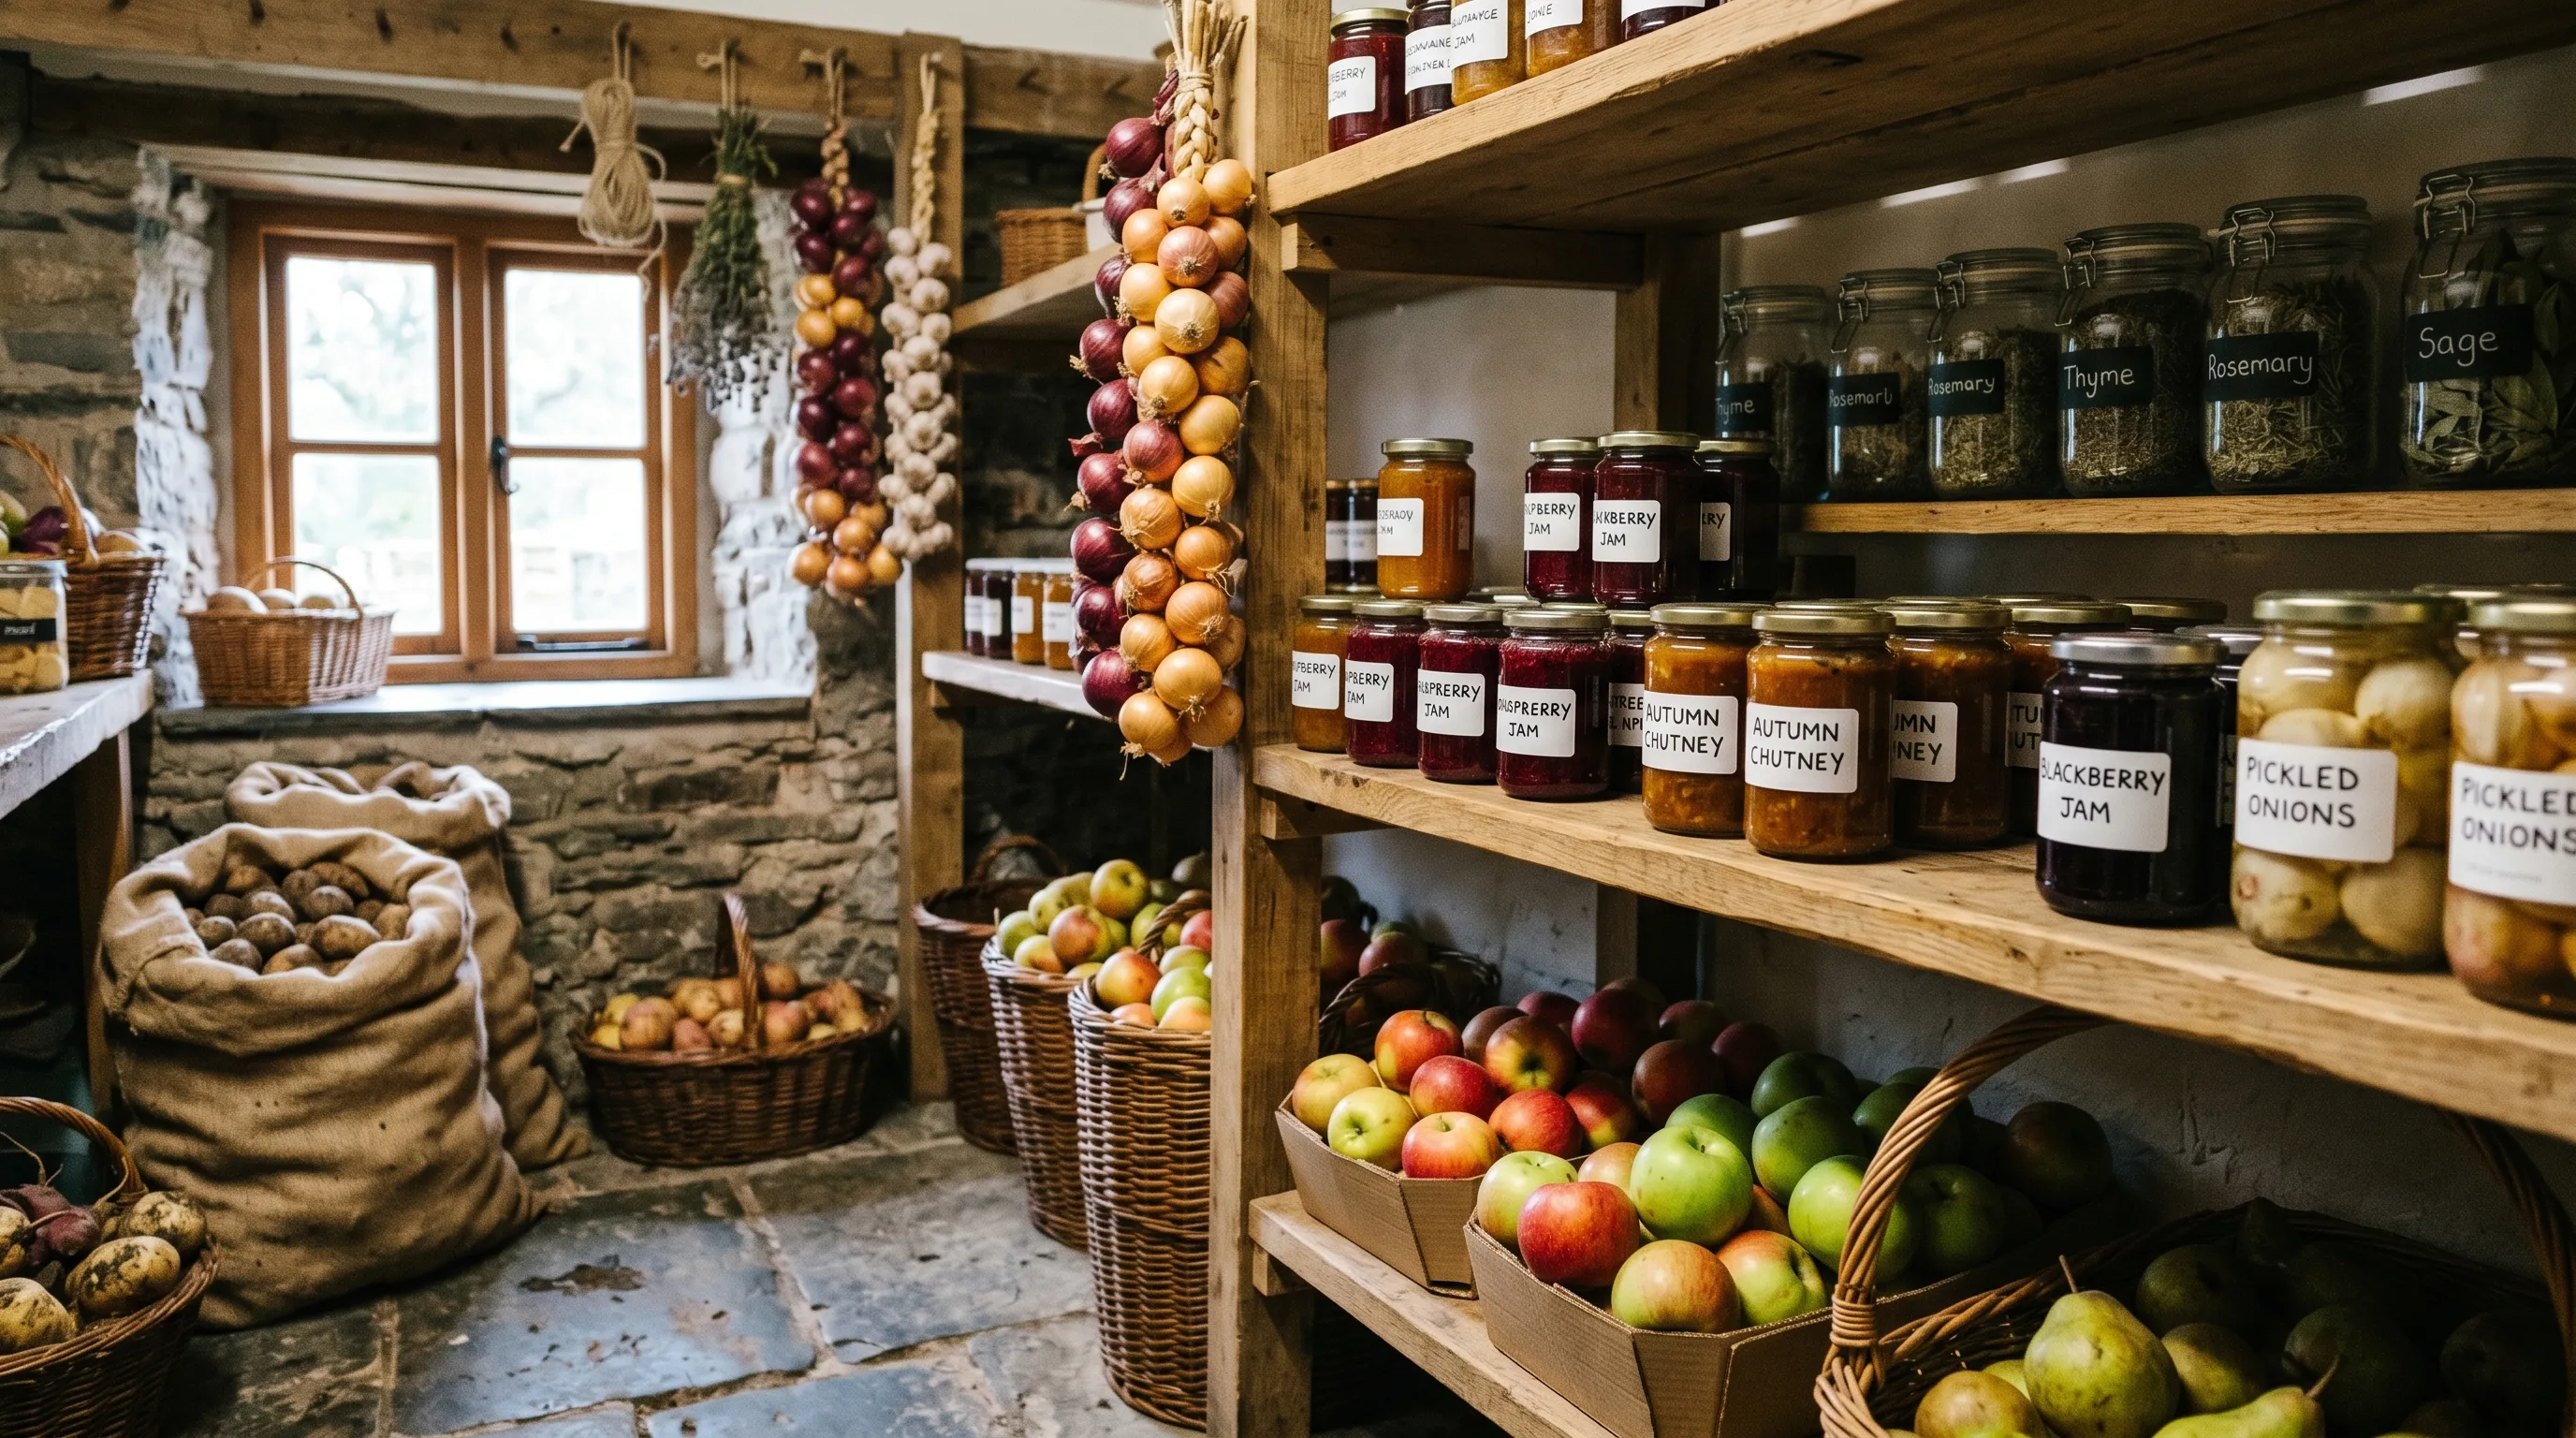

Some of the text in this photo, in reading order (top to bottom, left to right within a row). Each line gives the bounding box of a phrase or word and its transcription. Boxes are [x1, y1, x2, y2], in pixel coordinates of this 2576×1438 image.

[1454, 33, 1475, 49] JAM
[2418, 326, 2499, 367] Sage
[2064, 365, 2134, 398] Thyme
[2208, 352, 2313, 385] Rosemary
[1928, 376, 1996, 396] Rosemary
[1715, 398, 1755, 424] Thyme
[1529, 523, 1551, 535] JAM
[1601, 533, 1626, 546] JAM
[1425, 703, 1450, 719] JAM
[1646, 703, 1720, 727] AUTUMN
[1509, 722, 1539, 738] JAM
[1753, 716, 1839, 742] AUTUMN
[1645, 730, 1724, 758] CHUTNEY
[1750, 745, 1845, 775] CHUTNEY
[2247, 756, 2360, 791] PICKLED
[2041, 756, 2166, 796] BLACKBERRY
[2059, 797, 2111, 824] JAM
[2247, 794, 2357, 829] ONIONS
[2462, 816, 2576, 857] ONIONS
